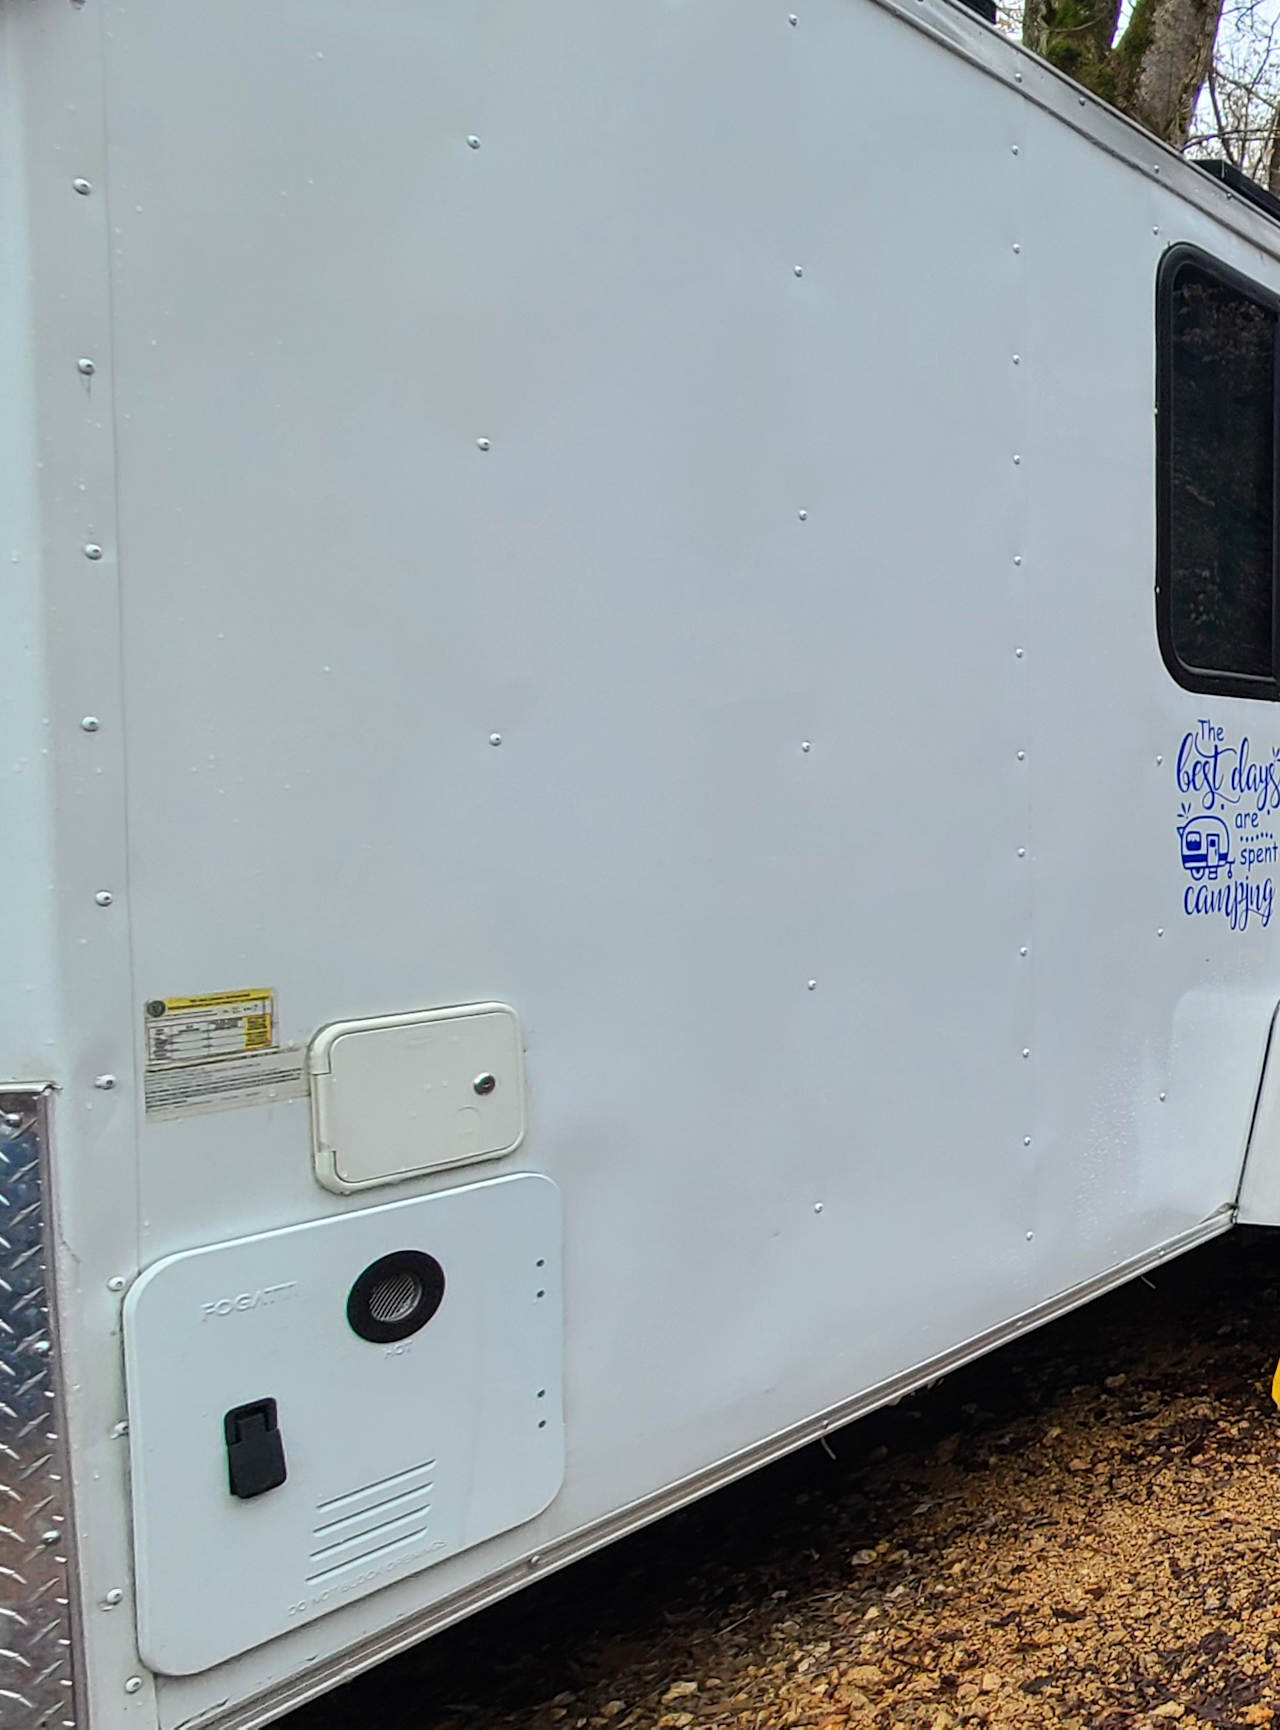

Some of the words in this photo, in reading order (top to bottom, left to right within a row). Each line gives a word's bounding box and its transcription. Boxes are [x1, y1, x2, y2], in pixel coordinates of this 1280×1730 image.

[1197, 719, 1225, 742] The
[1176, 732, 1237, 810] best
[1235, 811, 1260, 829] are
[1239, 842, 1279, 872] spent
[1183, 876, 1276, 931] camping
